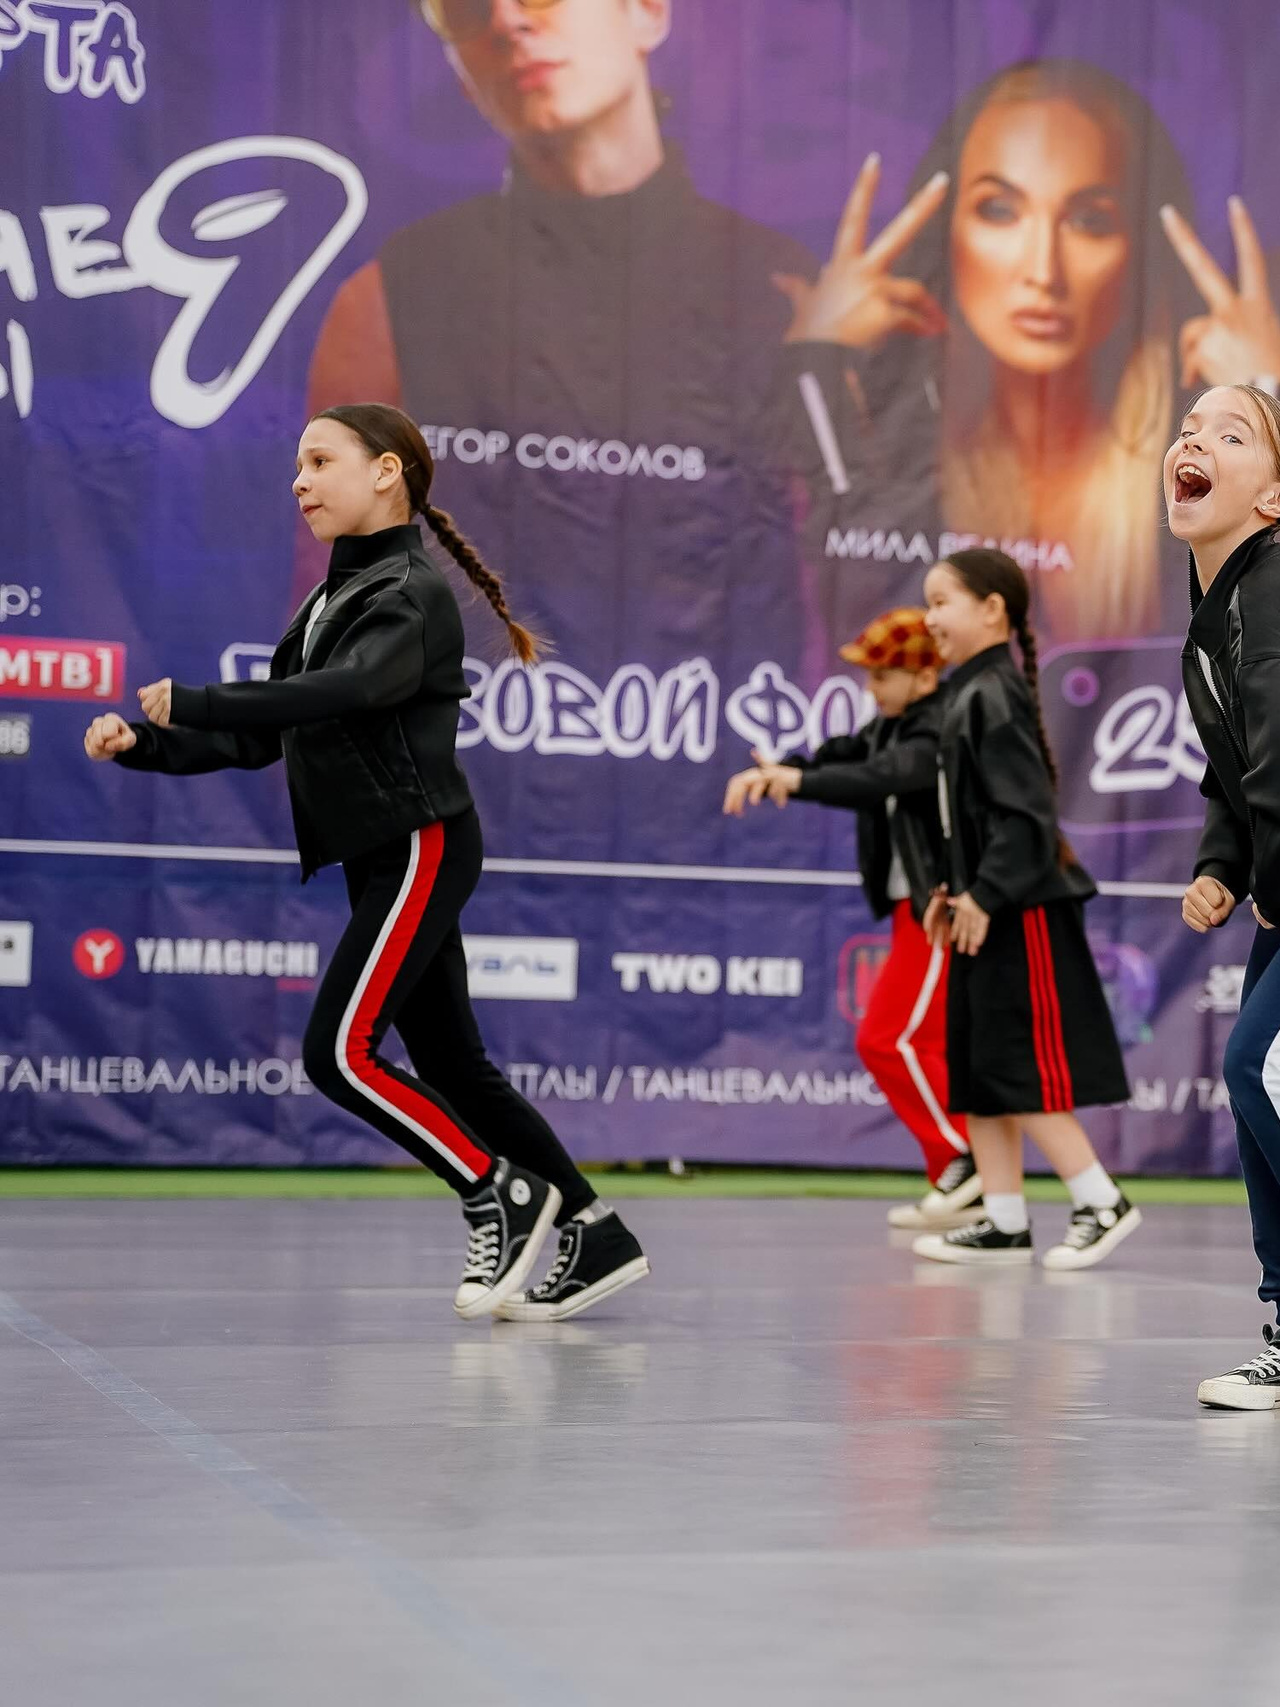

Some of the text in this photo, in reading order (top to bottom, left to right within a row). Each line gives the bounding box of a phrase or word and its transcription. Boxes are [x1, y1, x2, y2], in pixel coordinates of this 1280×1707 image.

[515, 432, 707, 482] СОКОЛОВ
[825, 527, 935, 566] МИЛА
[135, 936, 319, 979] YAMAGUCHI
[611, 952, 721, 995] TWO
[627, 1064, 887, 1107] ТАНЦЕВАЛЬНО
